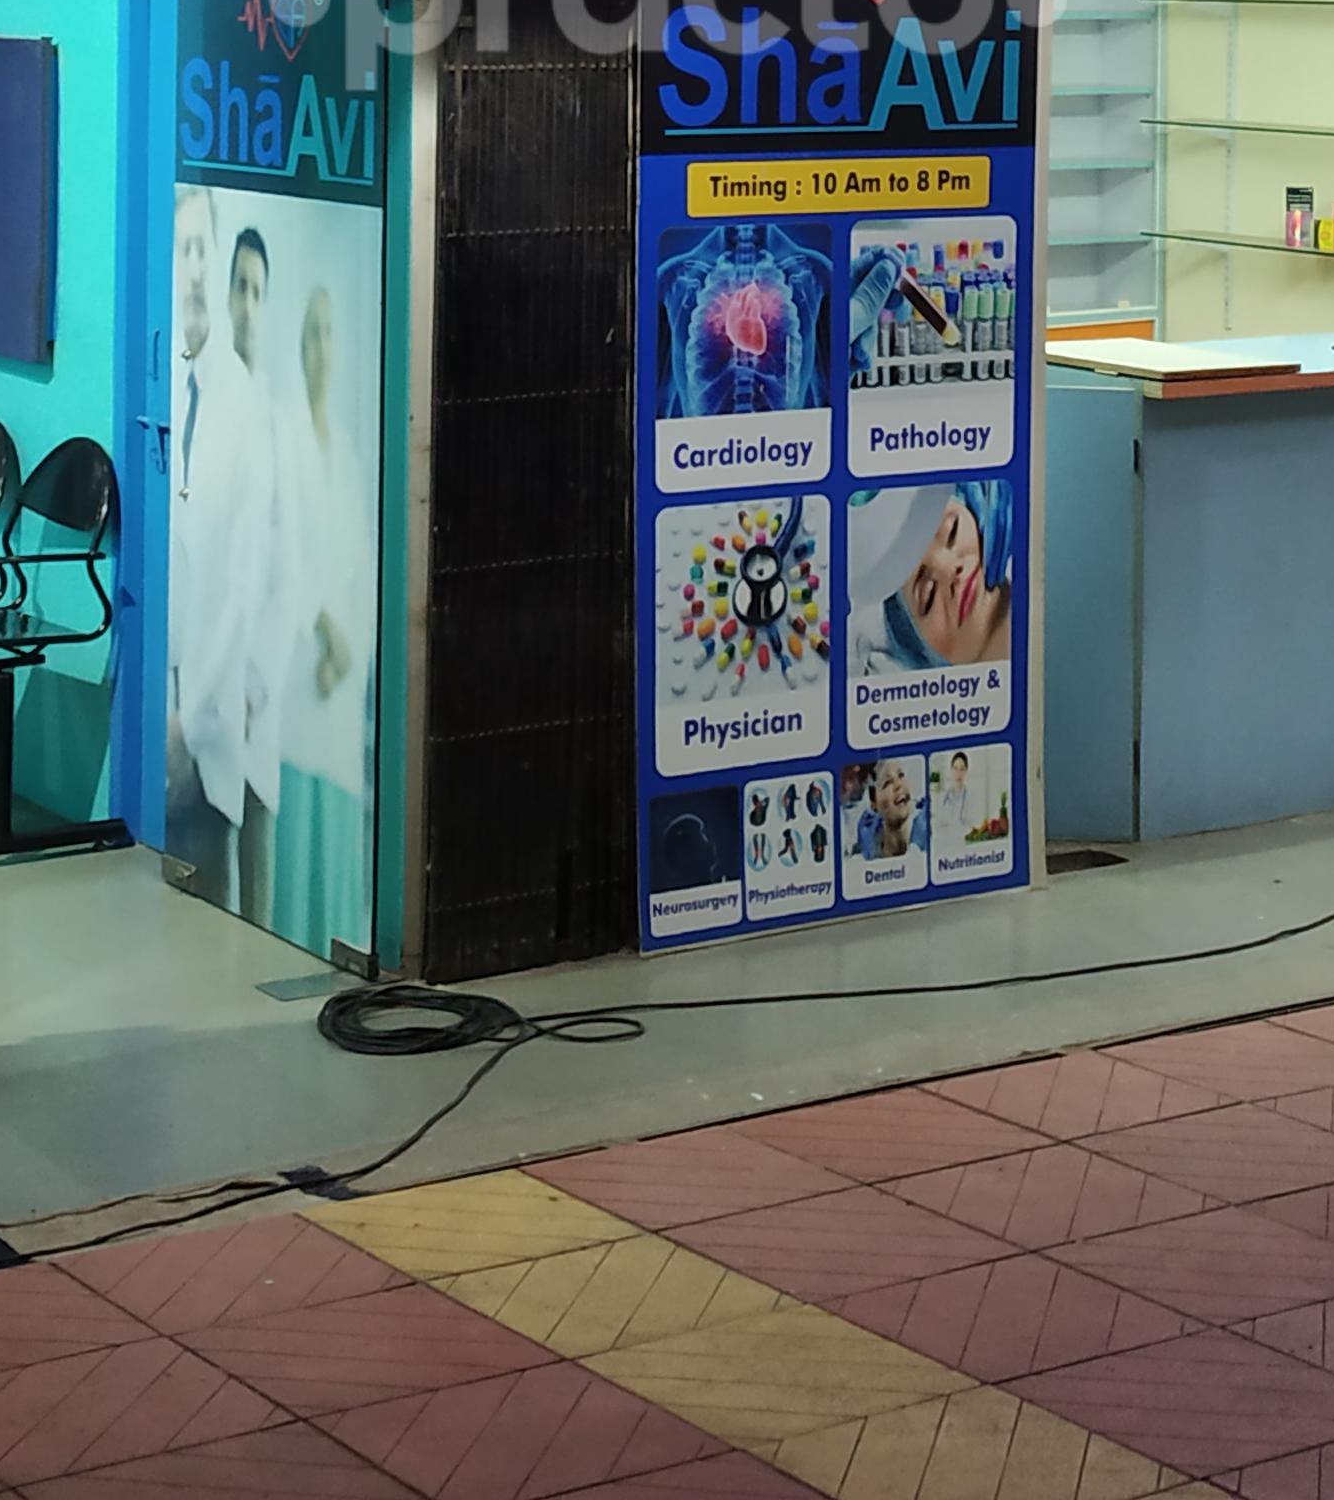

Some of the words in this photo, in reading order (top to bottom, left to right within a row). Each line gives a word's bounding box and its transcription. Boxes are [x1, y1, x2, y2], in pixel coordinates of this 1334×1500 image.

[710, 175, 788, 201] Timing
[811, 174, 837, 195] 10
[845, 173, 880, 193] Am
[889, 173, 909, 193] to
[917, 171, 930, 191] 8
[938, 170, 971, 190] Pm
[673, 436, 814, 471] Cardiology
[870, 424, 992, 453] Pathology
[856, 670, 981, 706] Dermatology
[987, 669, 1001, 690] &
[684, 709, 803, 750] Physician
[868, 703, 992, 737] Cosmetology
[865, 866, 906, 885] Dental
[938, 849, 1006, 872] Nutritionist
[652, 893, 739, 921] Neurosurgery
[748, 880, 833, 907] Physiotherapy
